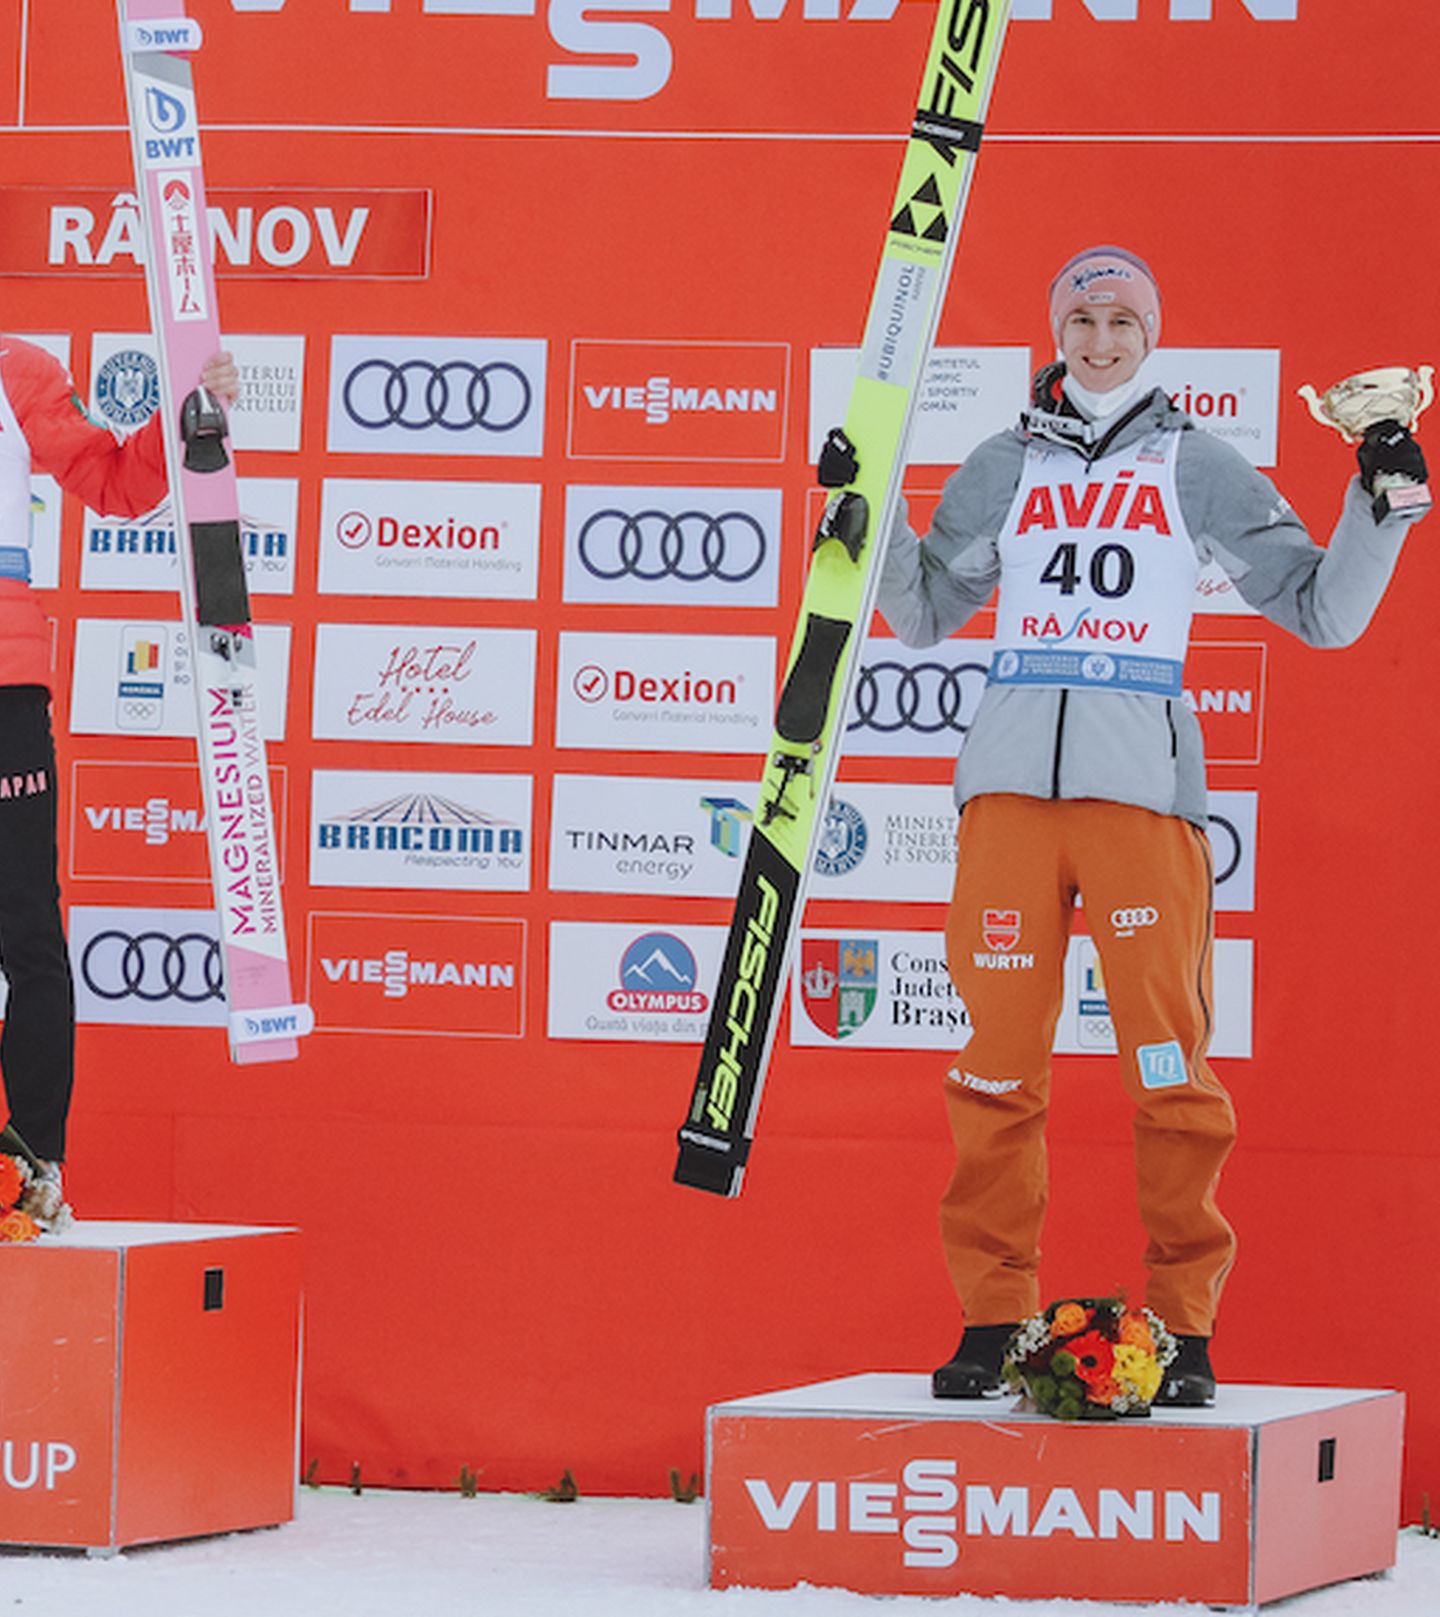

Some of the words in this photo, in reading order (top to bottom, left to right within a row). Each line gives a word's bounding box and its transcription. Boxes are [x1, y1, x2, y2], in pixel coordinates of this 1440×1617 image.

[154, 28, 190, 44] BWT
[145, 137, 195, 159] BWT
[48, 192, 370, 267] RÂNOV
[241, 365, 296, 380] TERUL
[583, 376, 777, 424] VIESSMANN
[377, 517, 500, 550] Dexion
[1040, 543, 1136, 599] 40
[379, 641, 478, 687] Hotel
[614, 671, 736, 704] Dexion
[347, 692, 412, 727] Edel
[420, 697, 499, 730] House
[208, 686, 258, 935] MAGNESIUM
[886, 815, 959, 831] MINIST
[246, 773, 278, 934] MINERALIZED
[318, 823, 523, 854] BRACOMA
[566, 830, 694, 855] TINMAR
[404, 854, 491, 870] Respecting
[615, 859, 693, 880] energy
[320, 950, 515, 998] VIESSMANN
[612, 991, 703, 1012] OLYMPUS
[706, 874, 780, 1133] FISCHER
[260, 1015, 297, 1034] BWT
[672, 1018, 698, 1033] din
[743, 1459, 1221, 1568] VIESSMANN
